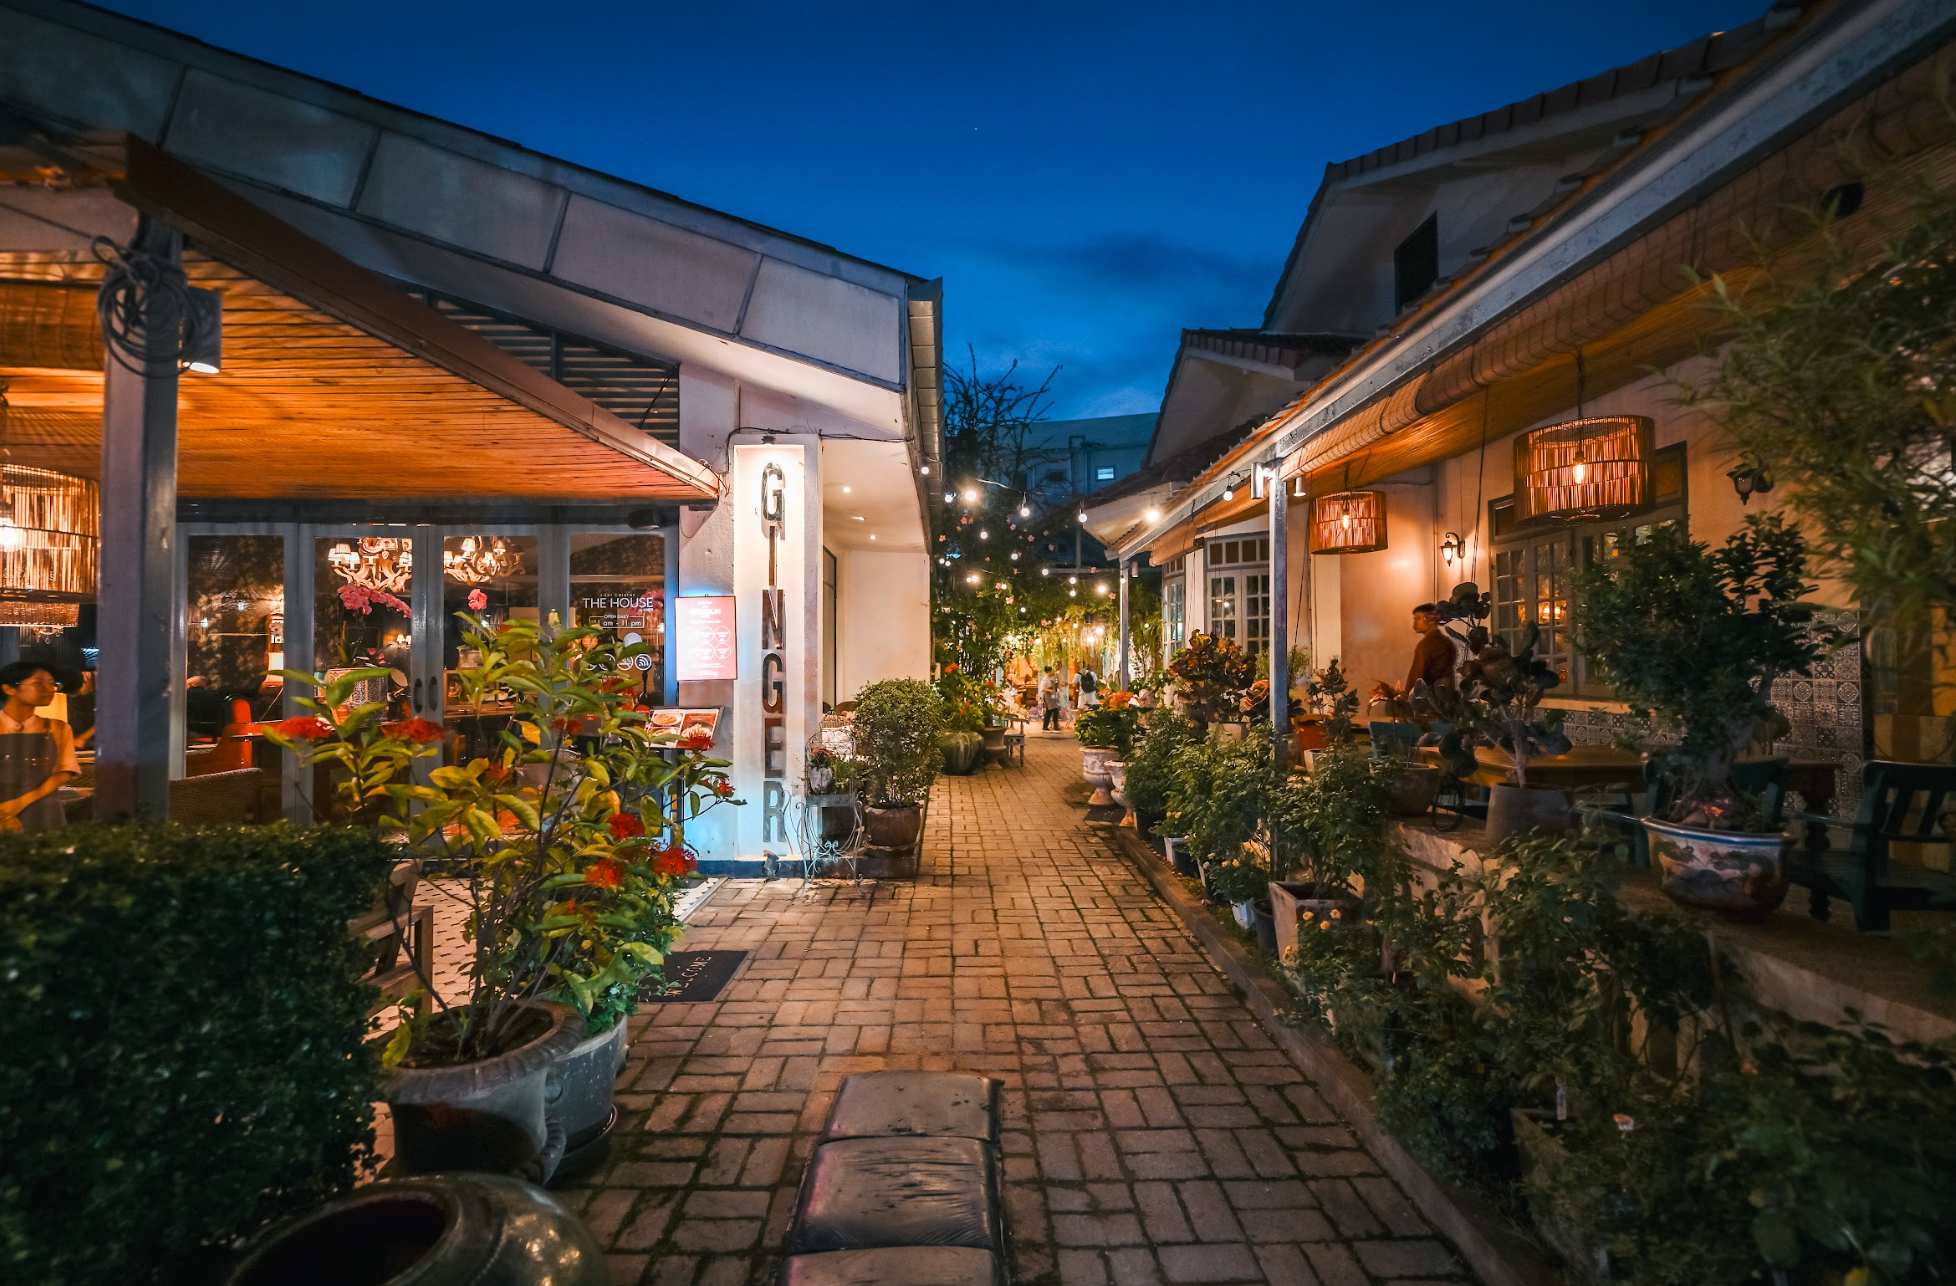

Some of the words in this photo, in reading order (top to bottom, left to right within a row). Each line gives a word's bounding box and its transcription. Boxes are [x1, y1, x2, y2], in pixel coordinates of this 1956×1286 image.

[583, 597, 607, 608] THE
[610, 597, 653, 608] HOUSE
[762, 462, 787, 843] GINGER
